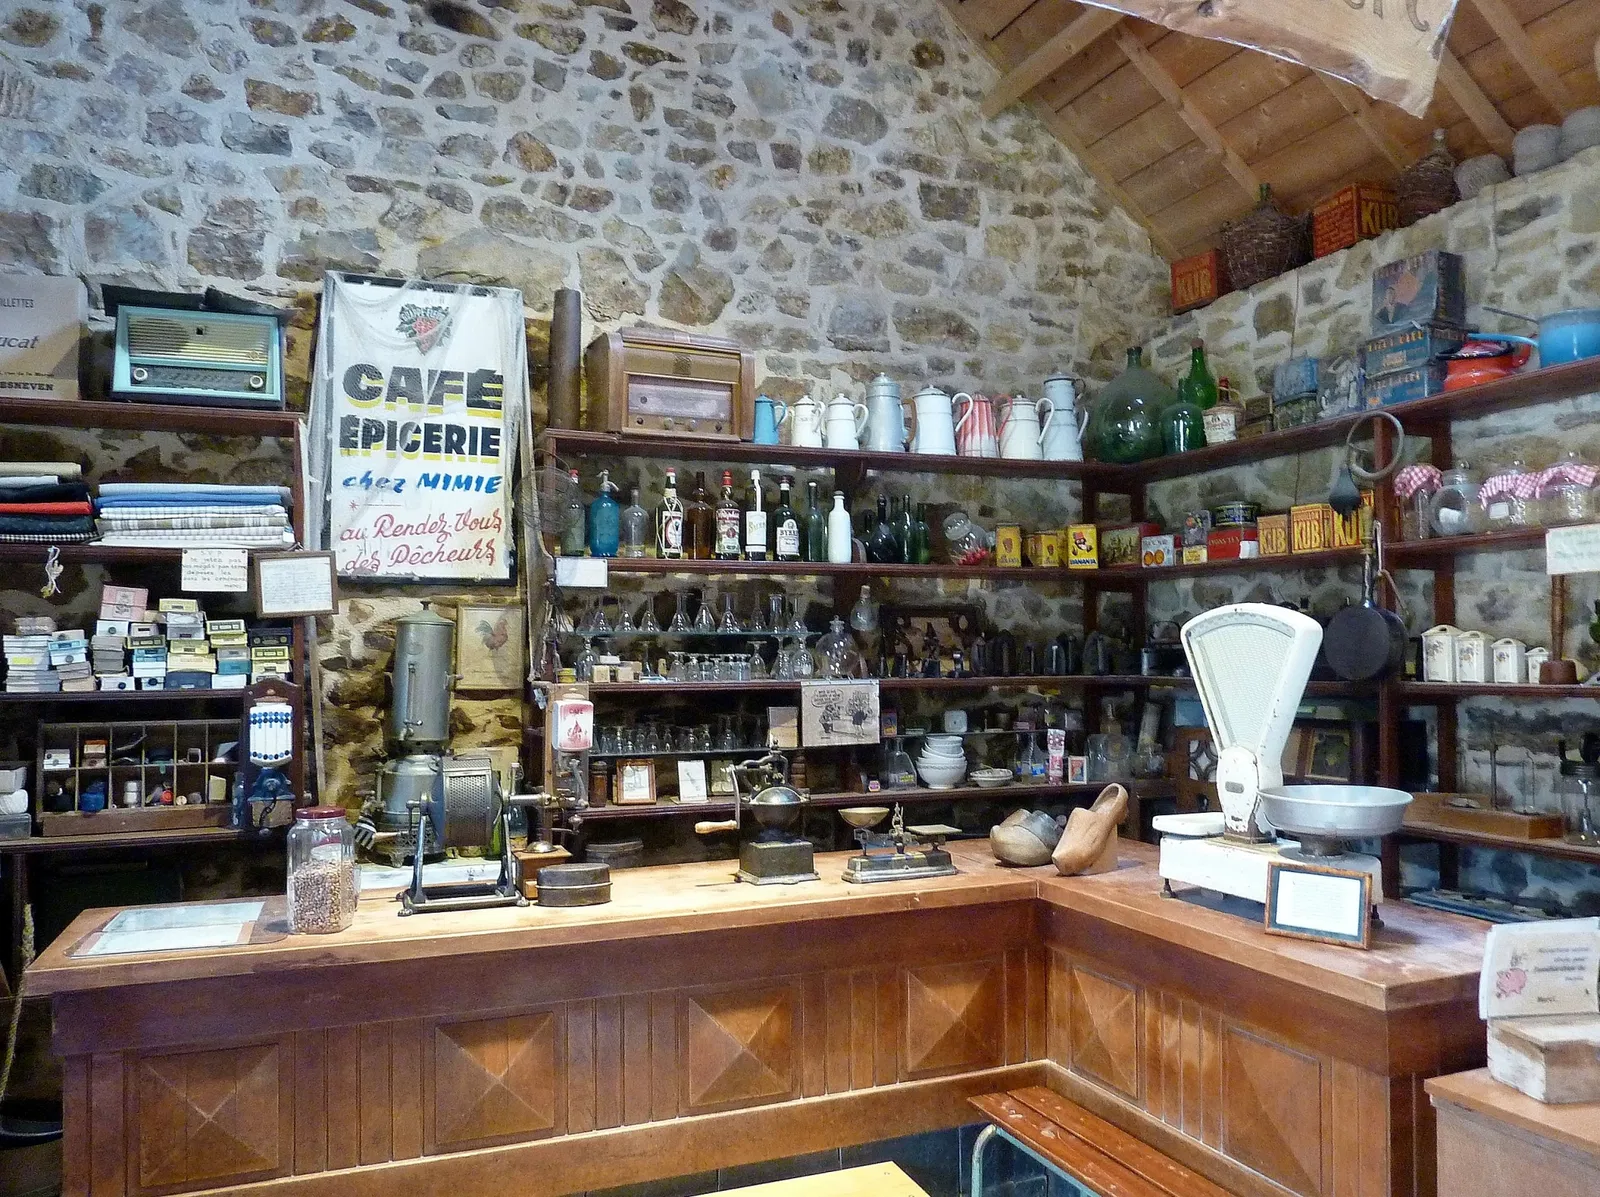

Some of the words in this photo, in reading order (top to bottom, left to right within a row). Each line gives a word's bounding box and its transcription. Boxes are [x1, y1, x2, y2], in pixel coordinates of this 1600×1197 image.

[343, 363, 504, 414] CAFÉ
[339, 414, 501, 459] ÉPICERIE
[342, 470, 406, 493] chez
[416, 472, 502, 494] MIMIE
[340, 527, 368, 541] au
[373, 508, 502, 543] Rendez-Vous
[1260, 527, 1287, 554] KUB
[1294, 519, 1321, 550] KUB
[1334, 509, 1365, 546] KU
[345, 551, 381, 573] des
[387, 538, 495, 567] Pêcheurs
[1069, 558, 1097, 566] BANANIA
